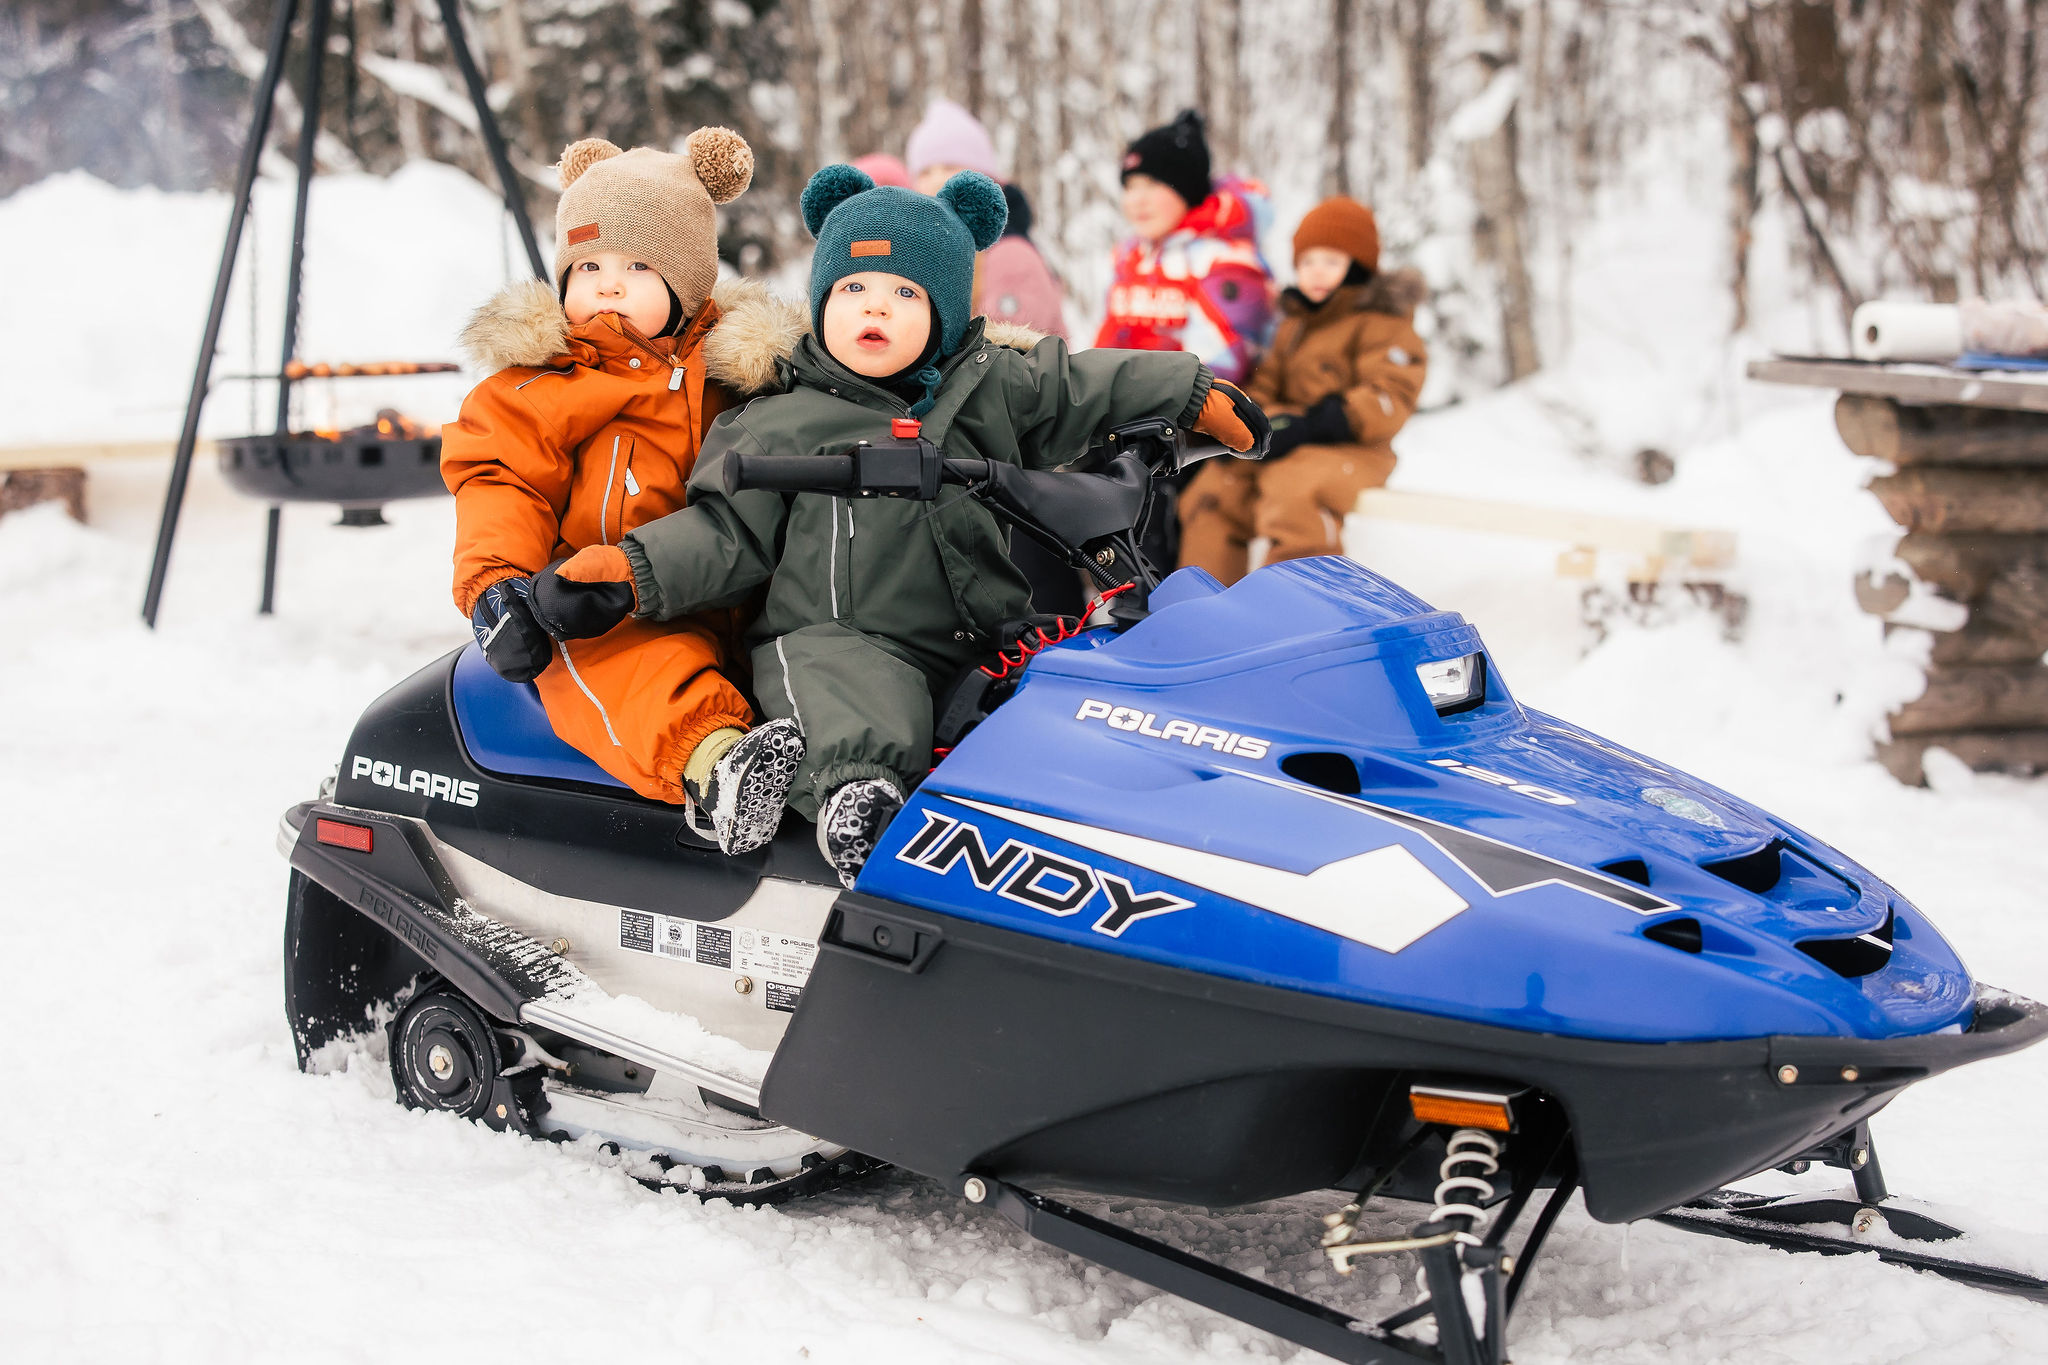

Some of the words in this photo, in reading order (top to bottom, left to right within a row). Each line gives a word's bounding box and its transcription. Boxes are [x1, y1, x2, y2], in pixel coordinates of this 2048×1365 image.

[1075, 698, 1272, 760] POLARIS
[351, 755, 480, 808] POLARIS
[895, 807, 1197, 939] INDY
[359, 887, 440, 961] POLARIS
[789, 939, 815, 949] POLARIS
